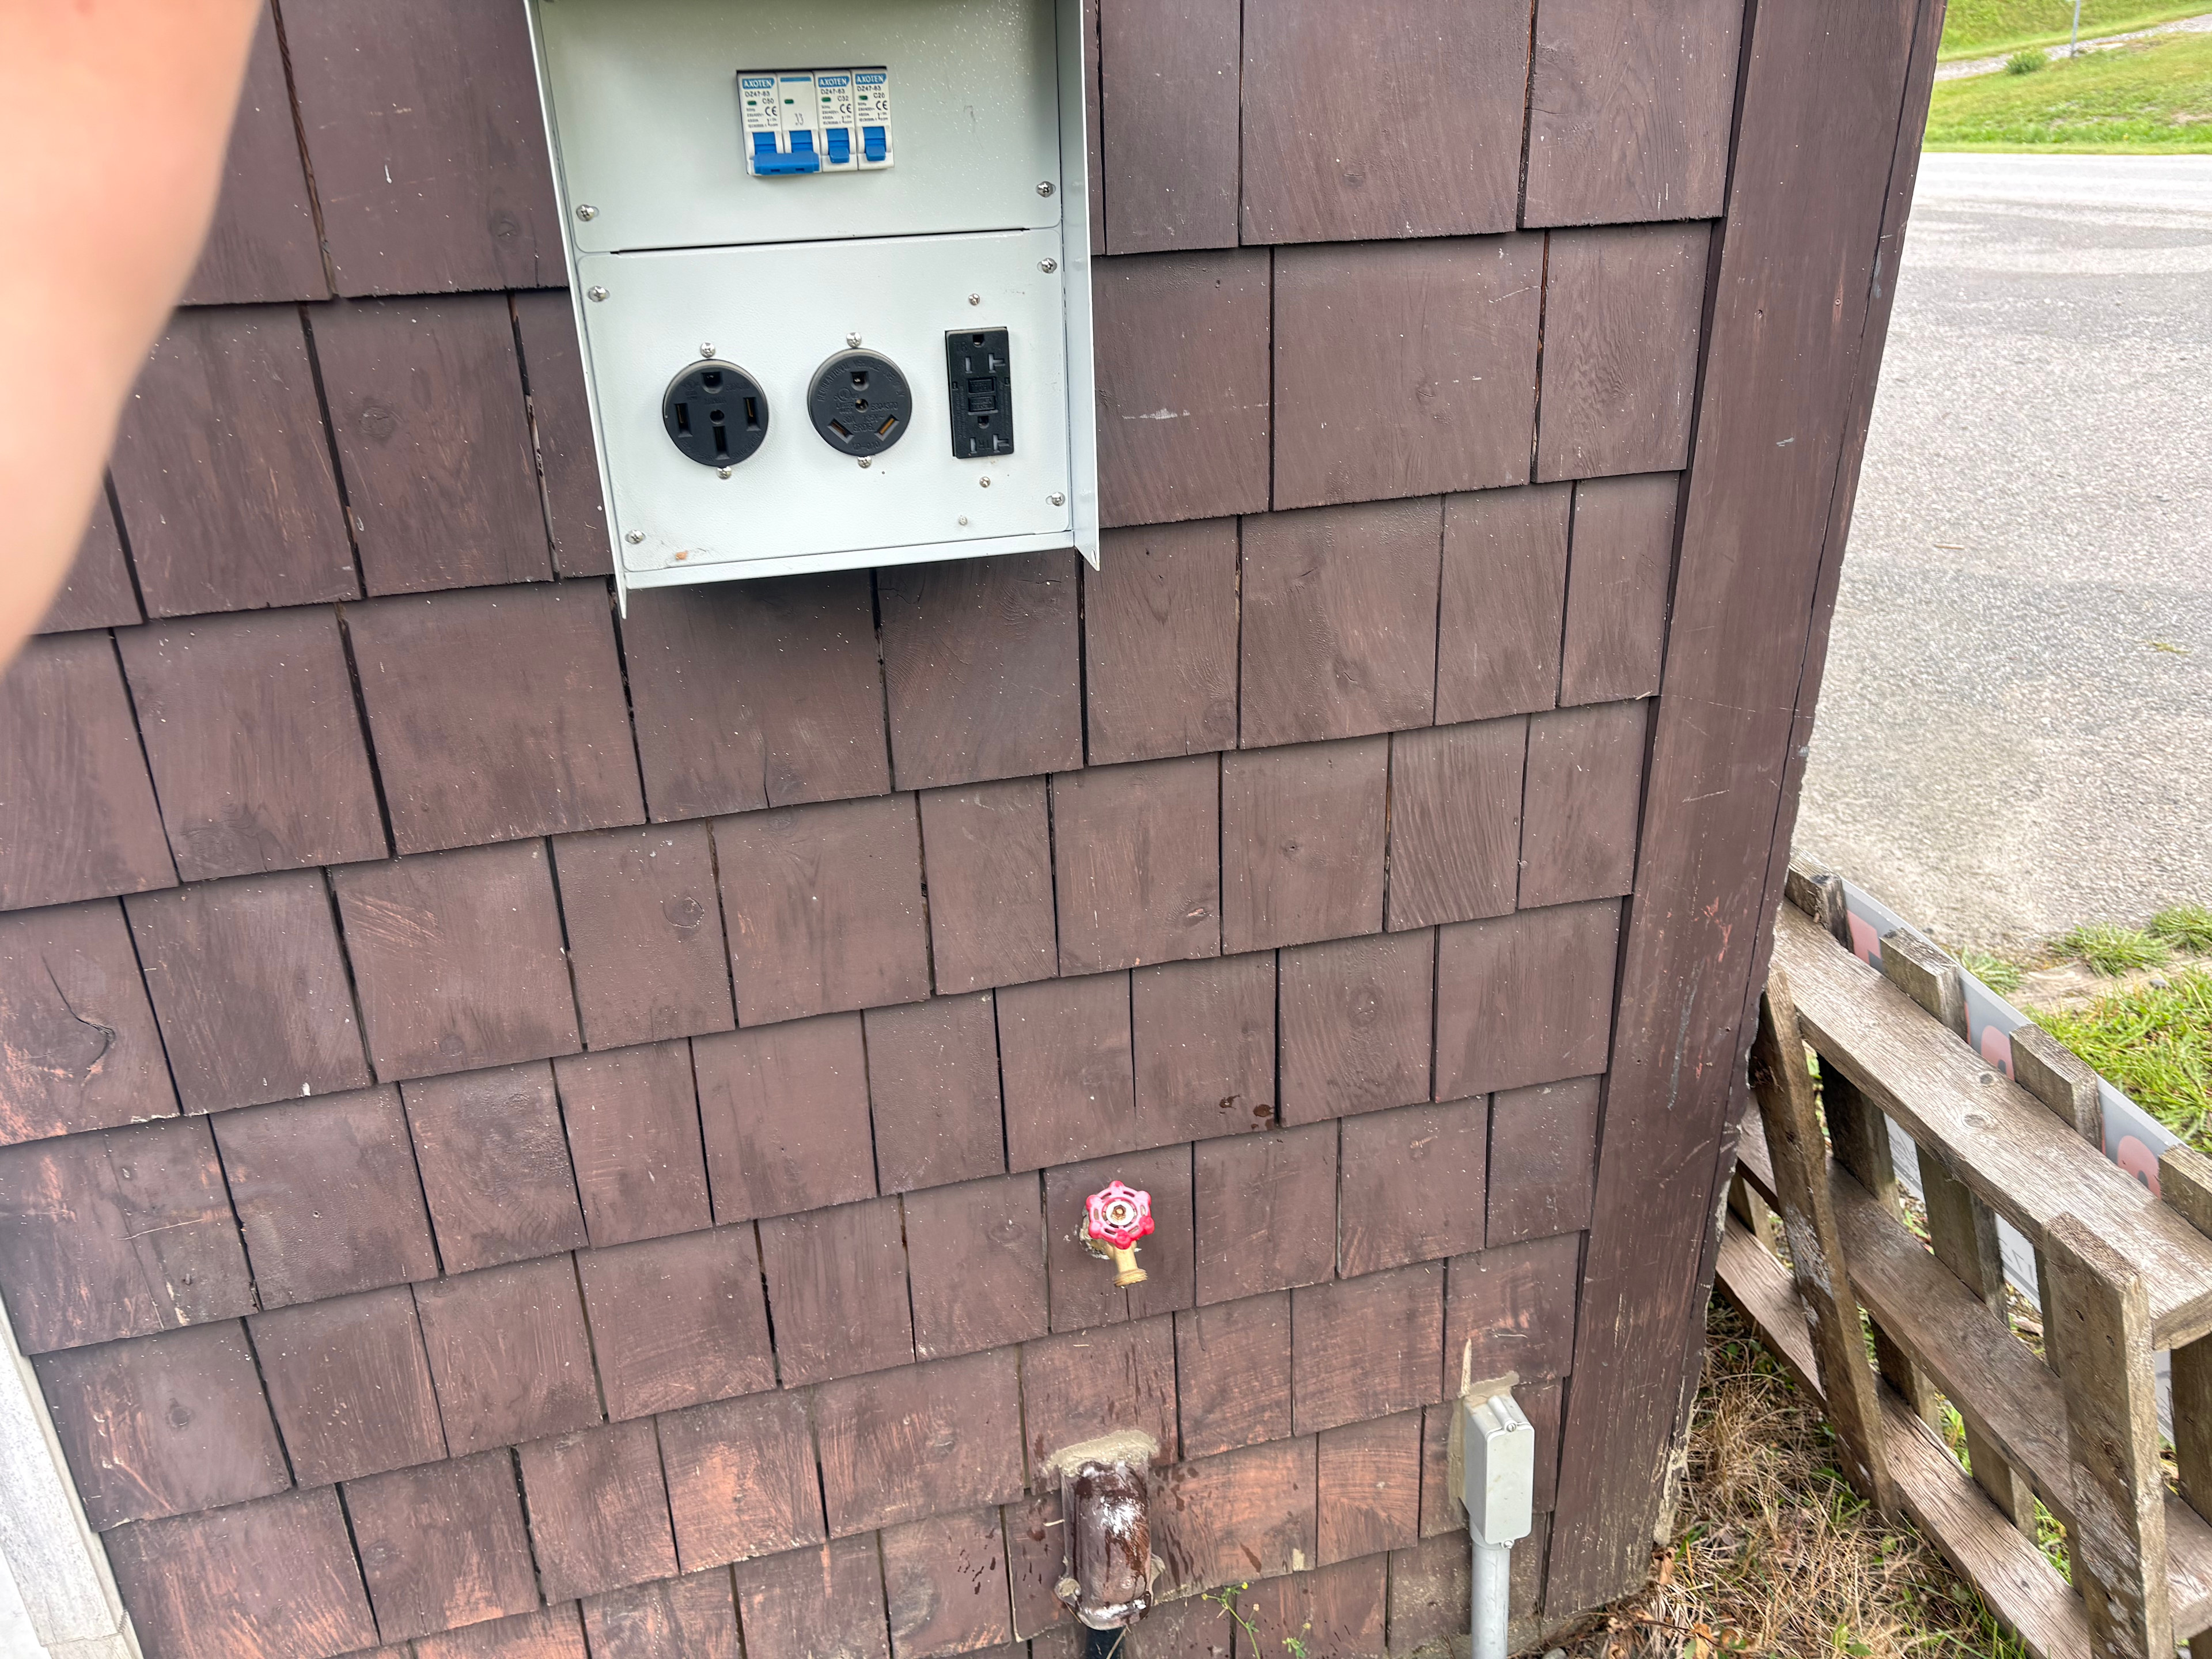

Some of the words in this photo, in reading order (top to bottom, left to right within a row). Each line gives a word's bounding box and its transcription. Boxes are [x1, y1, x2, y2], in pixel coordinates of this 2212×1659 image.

[744, 79, 773, 88] AXOTEN
[820, 78, 847, 86] AXOTEN
[857, 75, 884, 84] AXOTEN
